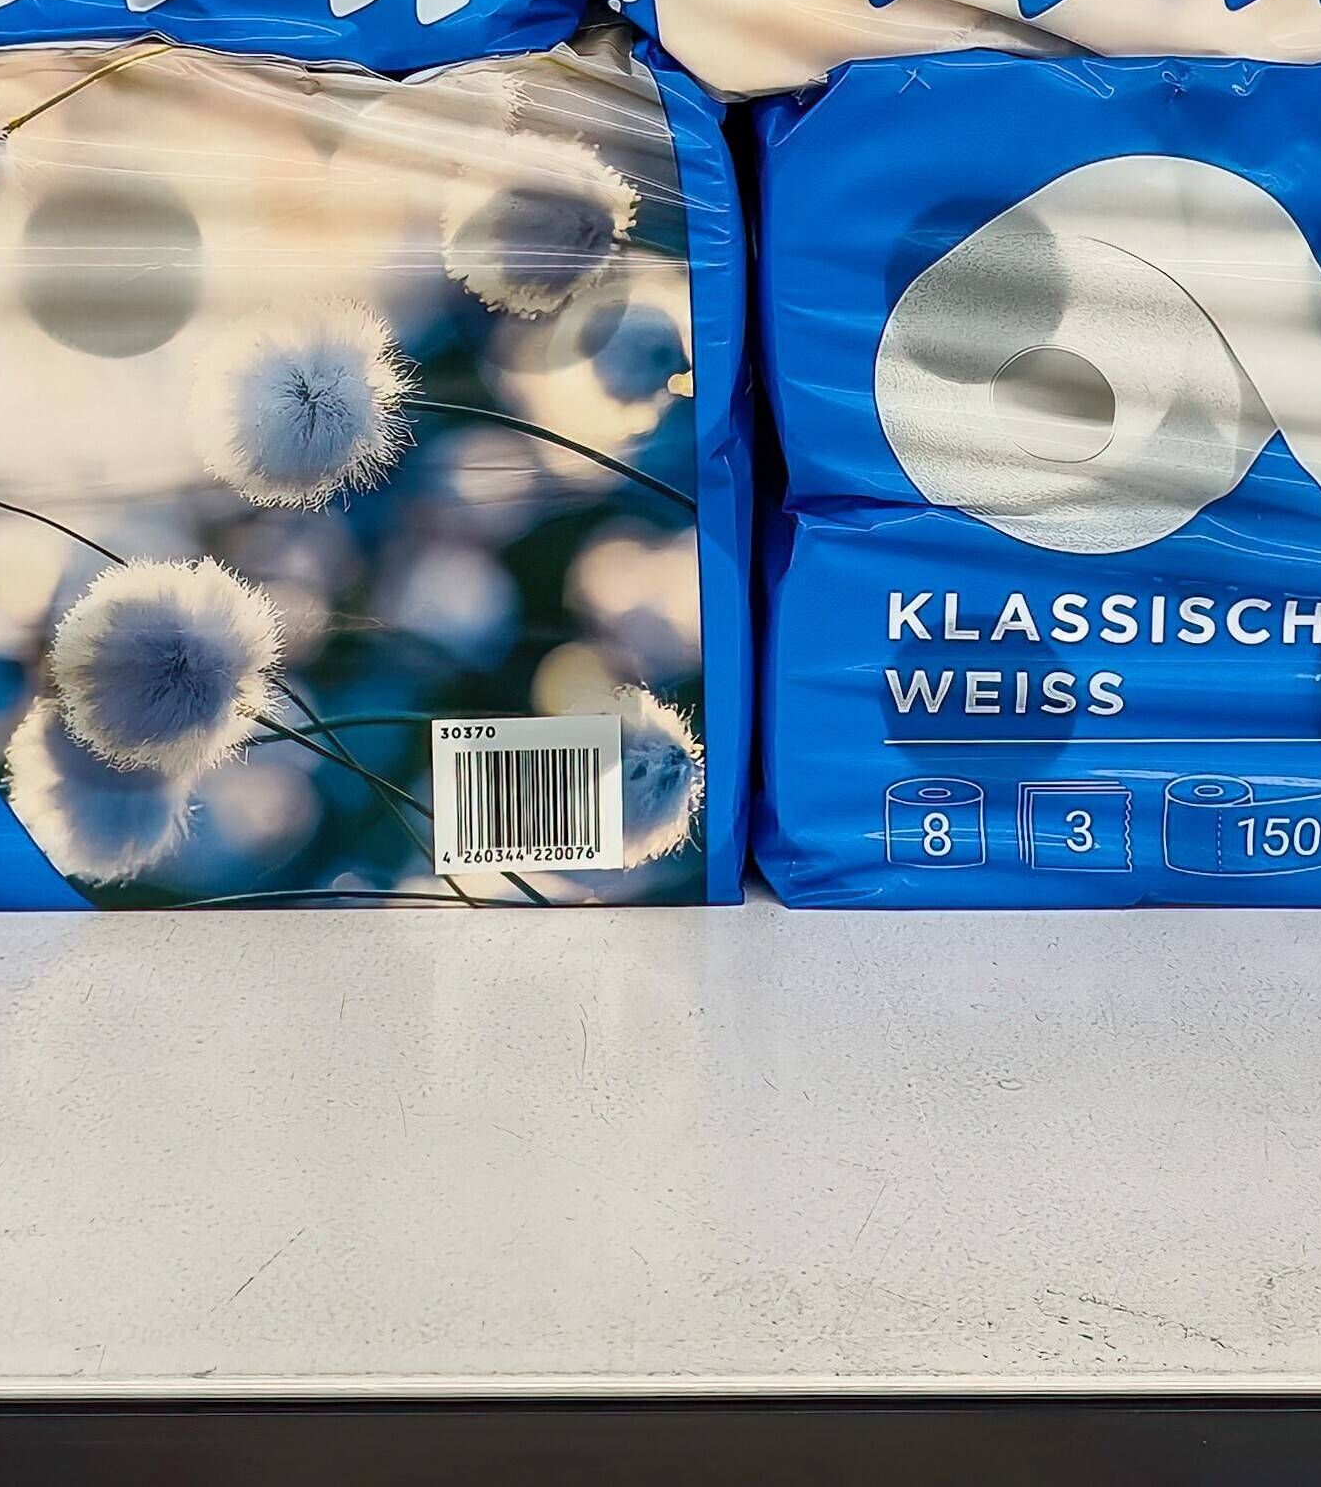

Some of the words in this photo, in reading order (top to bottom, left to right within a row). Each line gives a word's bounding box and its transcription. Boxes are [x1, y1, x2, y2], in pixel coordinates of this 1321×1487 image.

[885, 669, 1125, 715] WEISS
[440, 726, 495, 739] 30370
[923, 813, 951, 856] 8
[1065, 811, 1093, 852] 3
[1238, 817, 1321, 857] 150
[443, 852, 450, 864] 4
[464, 846, 524, 863] 260344
[534, 846, 594, 861] 220076
